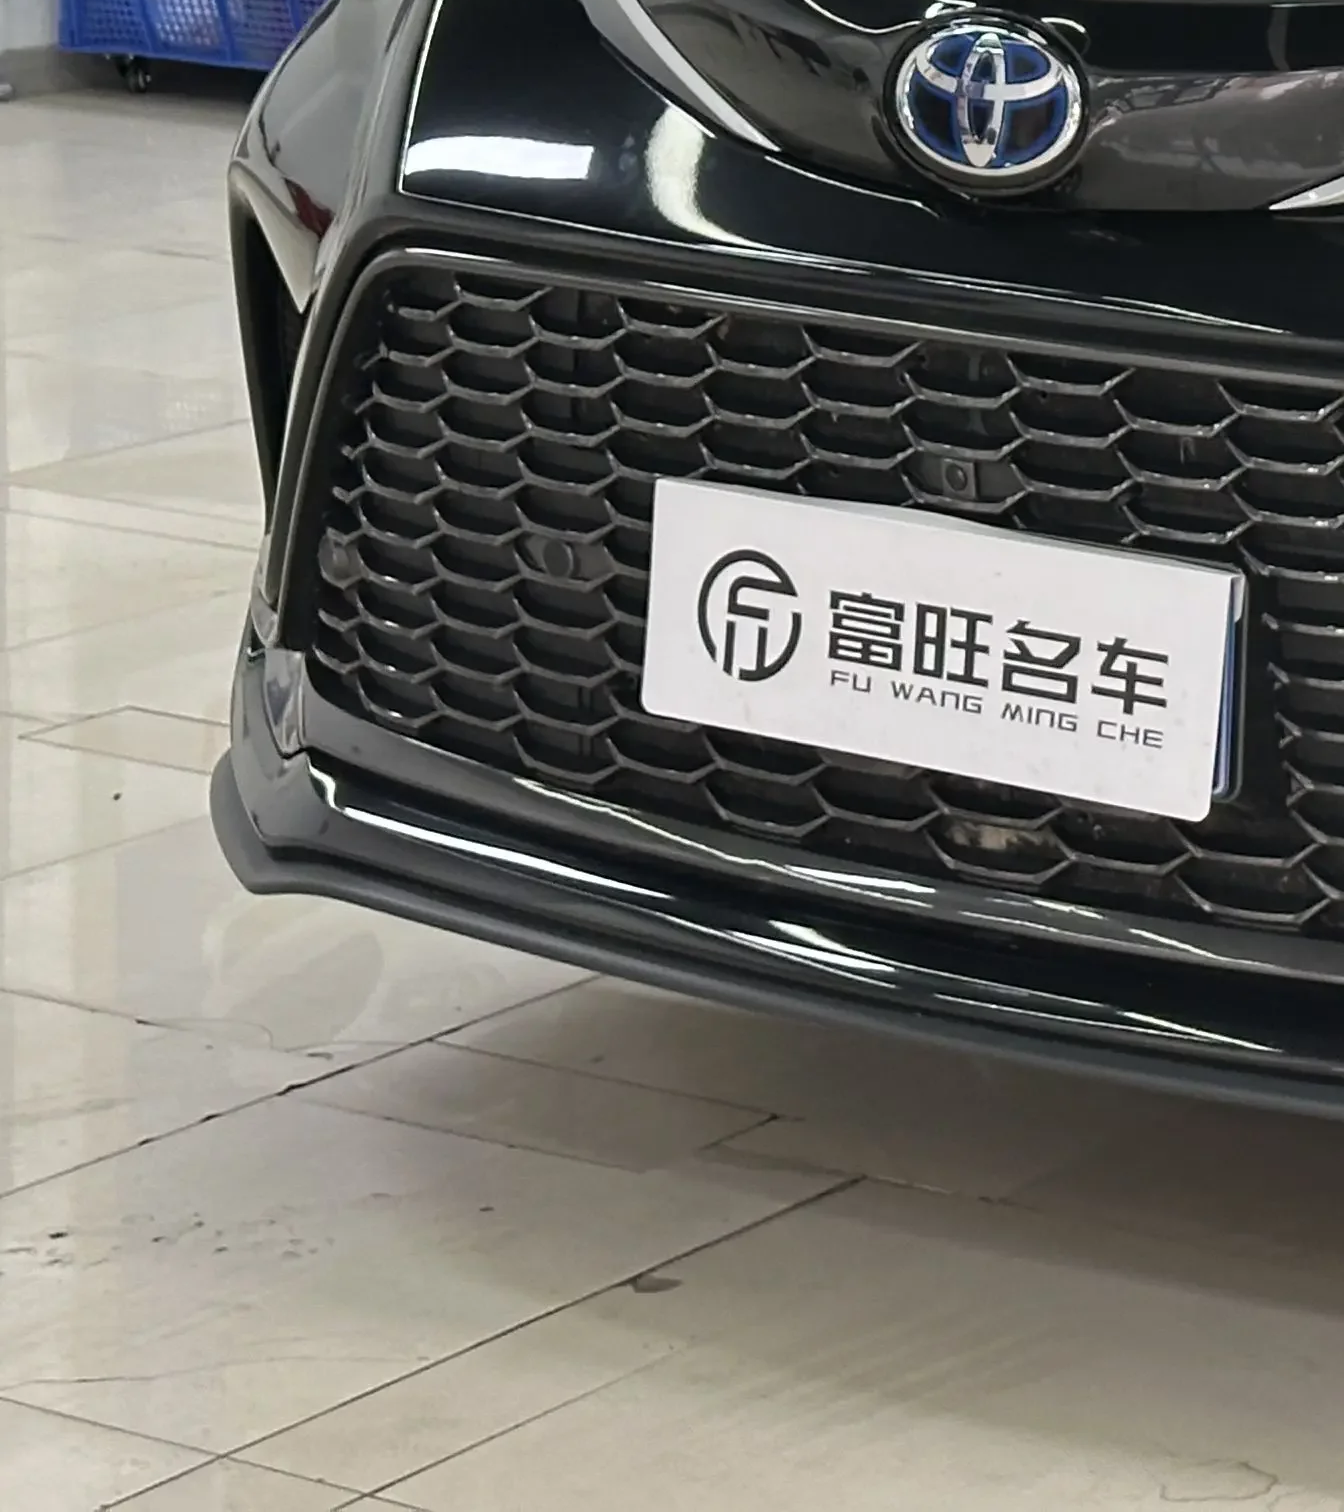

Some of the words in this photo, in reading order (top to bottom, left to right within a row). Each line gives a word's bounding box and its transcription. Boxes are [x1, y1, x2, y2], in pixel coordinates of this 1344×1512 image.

[828, 589, 1169, 716] 富旺名车
[830, 669, 872, 693] FU
[891, 680, 983, 714] WANG
[1000, 702, 1079, 733] MING
[1097, 719, 1164, 749] CHE
